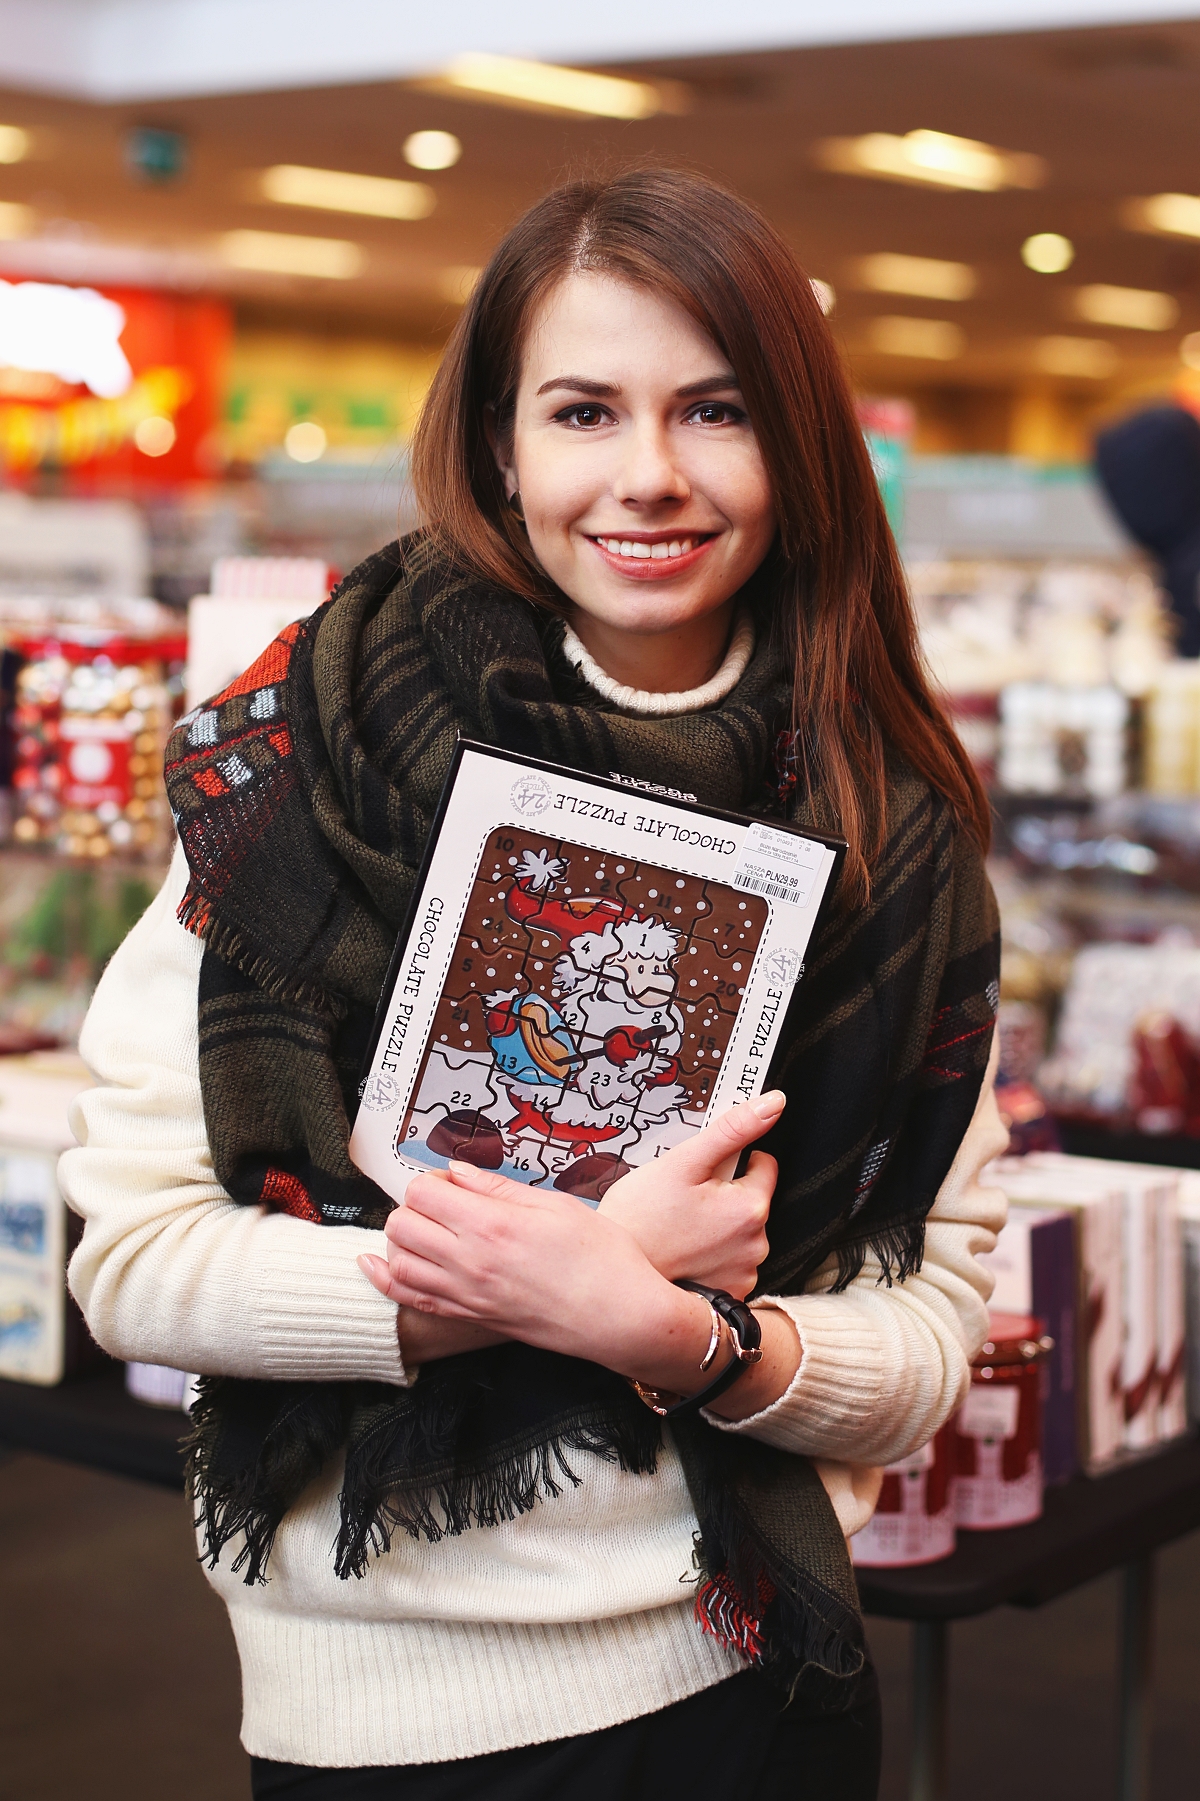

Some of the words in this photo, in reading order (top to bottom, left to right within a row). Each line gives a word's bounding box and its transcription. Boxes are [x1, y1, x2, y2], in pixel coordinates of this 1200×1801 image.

[518, 789, 546, 808] 24
[554, 793, 628, 826] PUZZLE
[634, 815, 736, 855] CHOCOLATE
[495, 836, 514, 852] 10
[744, 862, 765, 873] NASZA
[746, 869, 764, 878] CENA
[600, 879, 611, 892] 2
[765, 870, 798, 887] PLN29,99
[656, 894, 672, 909] 11
[725, 923, 735, 937] 7
[404, 897, 444, 998] CHOCOLATE
[581, 941, 590, 954] 4
[640, 934, 647, 947] 1
[462, 958, 473, 972] 5
[771, 954, 791, 982] 24
[715, 980, 738, 997] 20
[452, 1006, 470, 1021] 21
[560, 1010, 578, 1026] 12
[651, 1011, 662, 1024] 8
[749, 988, 783, 1058] PUZZLE
[381, 1002, 413, 1072] PUZZLE
[697, 1034, 717, 1049] 15
[500, 1054, 517, 1069] 13
[590, 1072, 611, 1086] 23
[700, 1078, 710, 1090] 3
[372, 1078, 392, 1105] 24
[450, 1090, 472, 1106] 22
[533, 1093, 549, 1108] 14
[607, 1113, 625, 1128] 19
[408, 1125, 418, 1138] 9
[513, 1157, 529, 1171] 16
